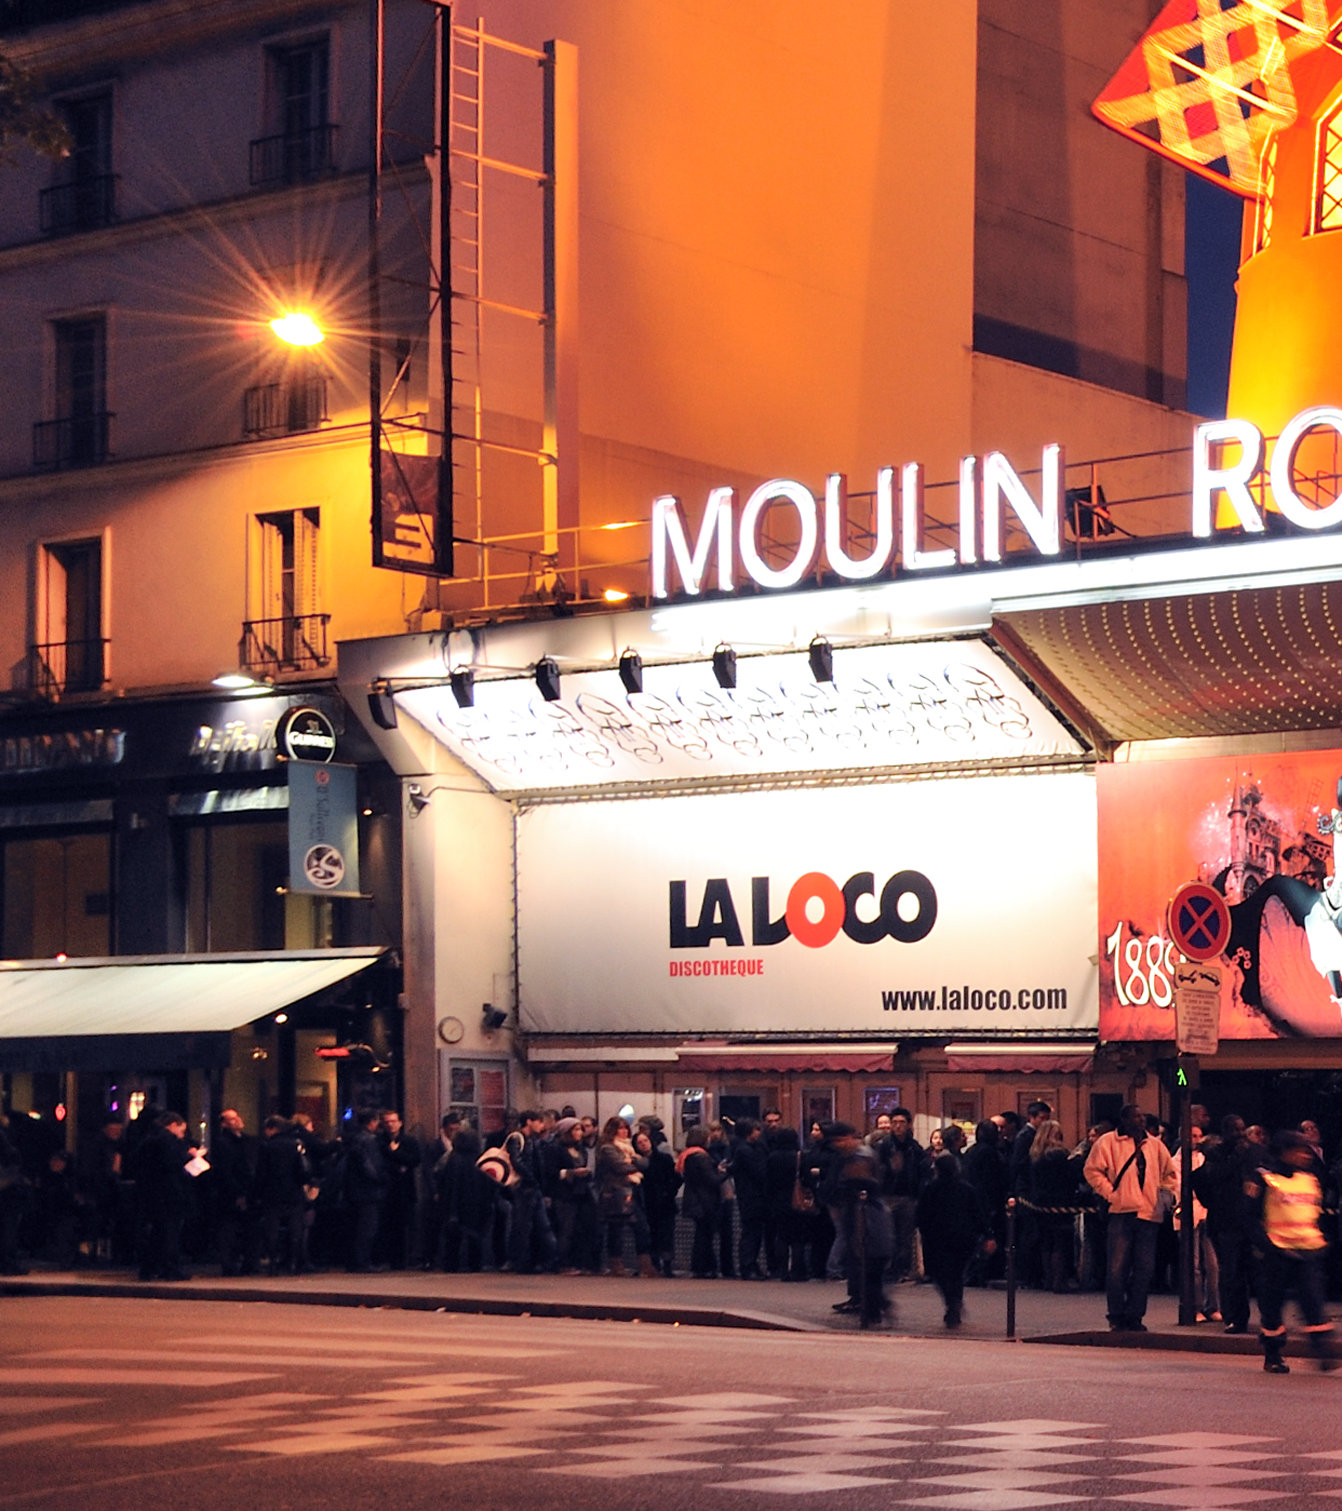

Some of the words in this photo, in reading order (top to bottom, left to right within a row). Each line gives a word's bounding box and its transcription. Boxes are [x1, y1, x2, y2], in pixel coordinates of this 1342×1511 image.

[651, 443, 1065, 599] MOULIN
[669, 878, 745, 948] LA
[752, 870, 938, 948] LOCO
[669, 959, 764, 978] DISCOTHEQUE
[882, 986, 1067, 1012] www.laloco.com
